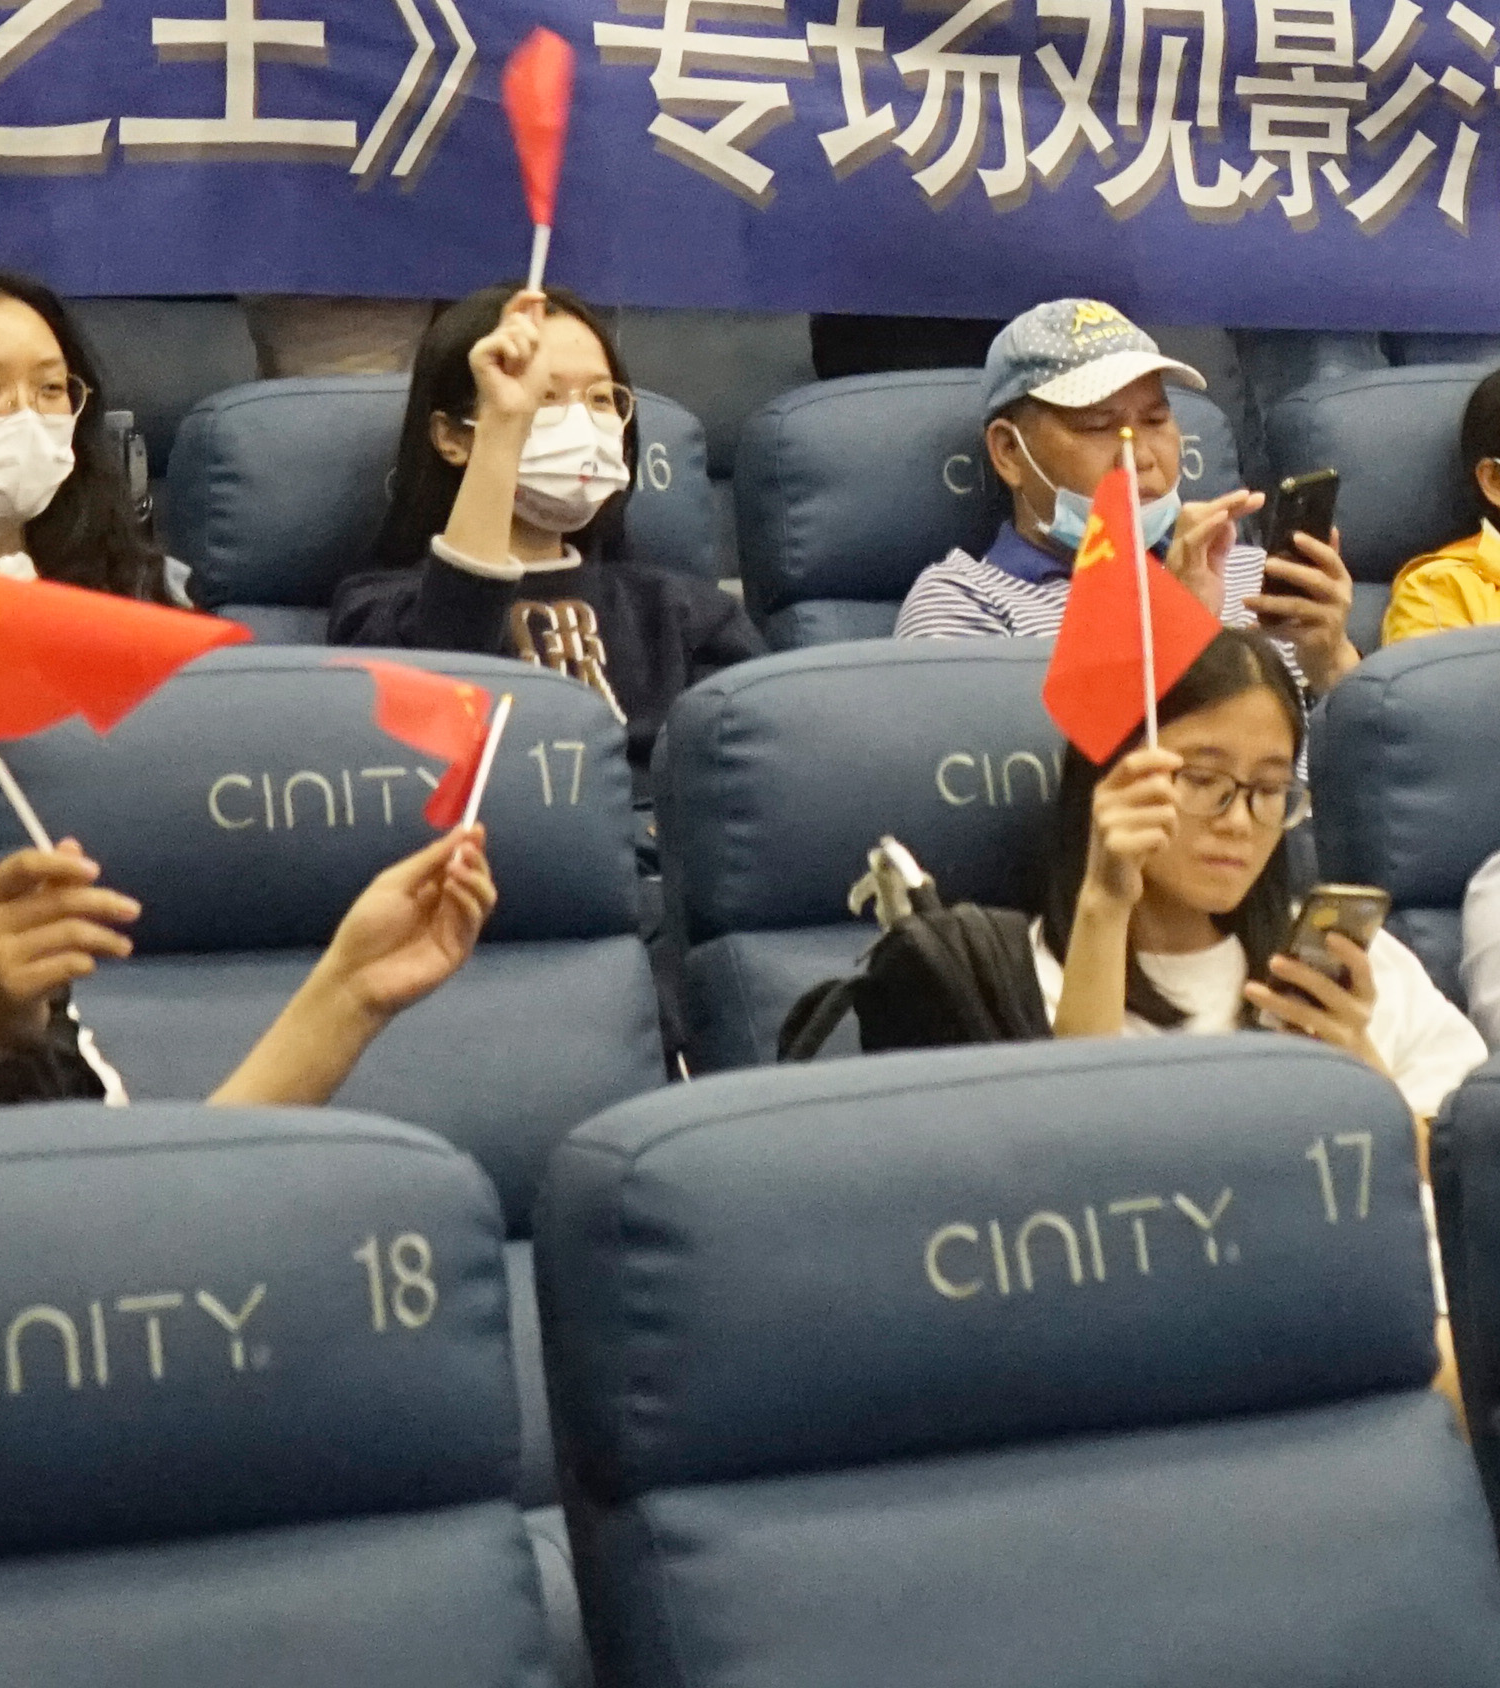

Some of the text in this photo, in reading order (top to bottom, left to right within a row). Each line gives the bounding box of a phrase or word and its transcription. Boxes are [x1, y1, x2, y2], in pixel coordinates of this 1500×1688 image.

[1180, 433, 1206, 481] 5
[207, 741, 586, 832] CINIT 17
[924, 1131, 1374, 1300] CINITY 17
[354, 1232, 440, 1333] 18
